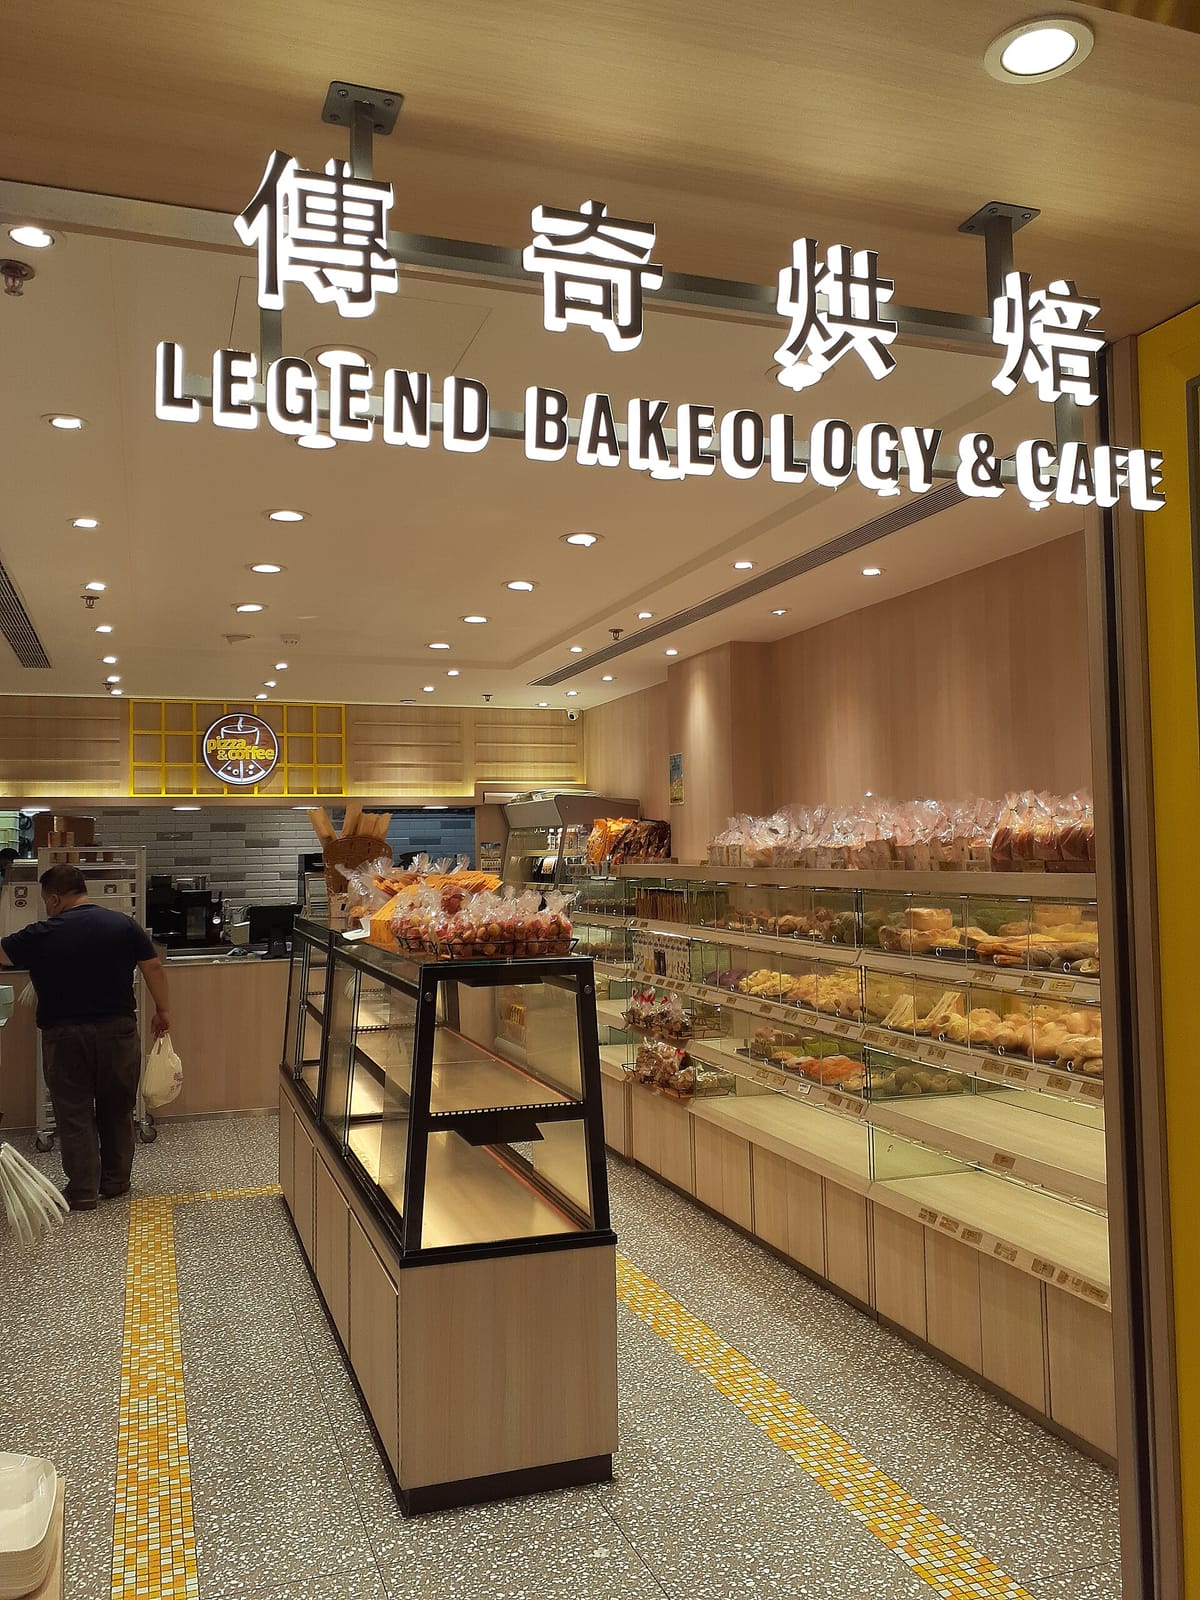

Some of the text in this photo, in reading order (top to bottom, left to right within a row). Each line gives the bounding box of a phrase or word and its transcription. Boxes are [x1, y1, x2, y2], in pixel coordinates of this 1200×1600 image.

[233, 150, 1106, 406] 傳奇烘焙
[156, 341, 1167, 511] LEGEND BAKEOLOGY & CAFE
[207, 736, 246, 753] pizza
